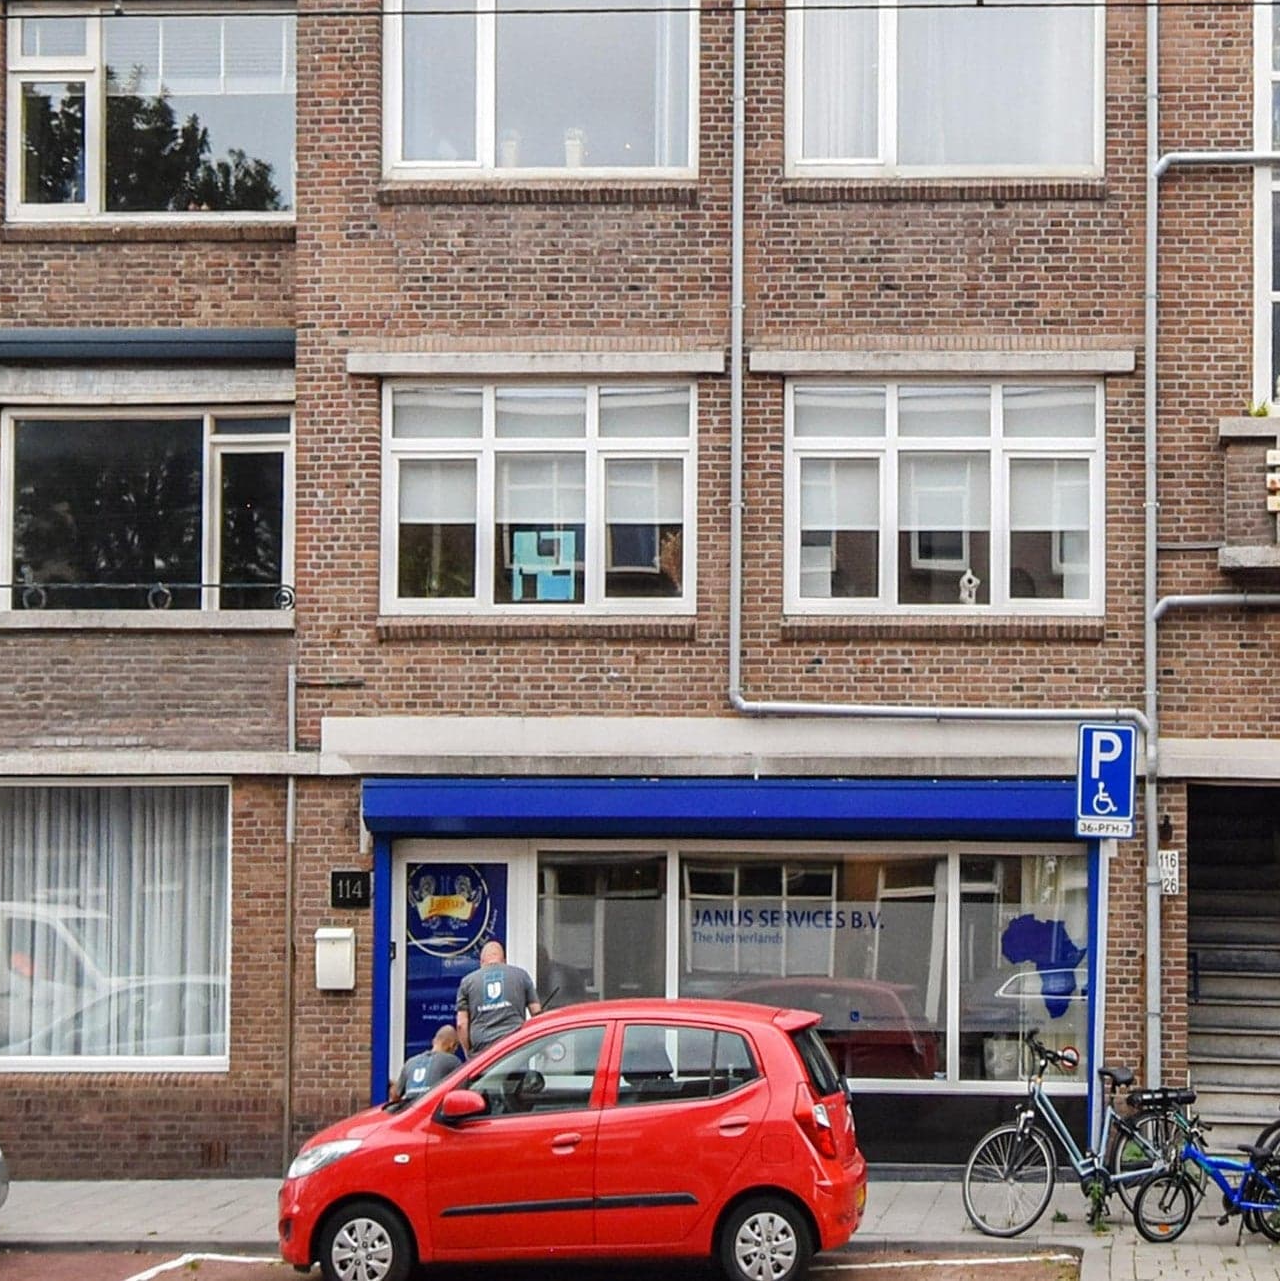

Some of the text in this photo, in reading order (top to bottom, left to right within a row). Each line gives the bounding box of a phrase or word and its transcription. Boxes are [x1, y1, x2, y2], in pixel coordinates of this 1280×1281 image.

[1091, 731, 1123, 779] P
[1159, 853, 1177, 868] 116
[337, 879, 362, 899] 114
[692, 909, 885, 930] JANUS SERVICES B.V.
[692, 931, 783, 945] The Netherlands
